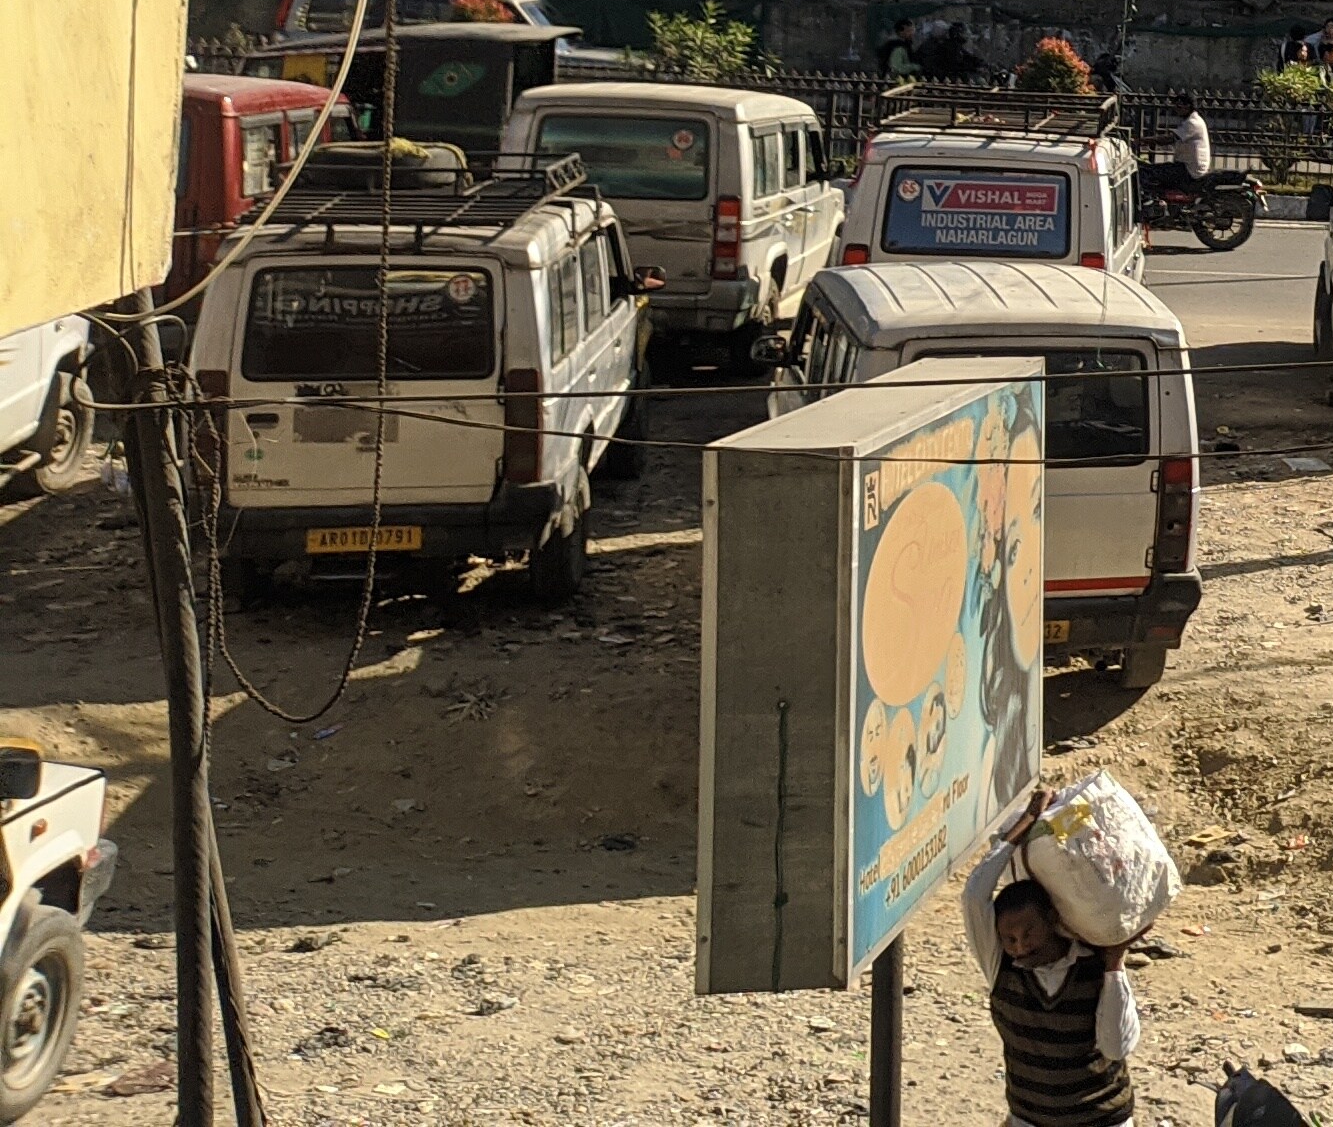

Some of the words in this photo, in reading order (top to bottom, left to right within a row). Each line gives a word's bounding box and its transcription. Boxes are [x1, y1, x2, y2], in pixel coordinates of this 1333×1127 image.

[957, 189, 1022, 205] VISHAL
[921, 213, 1011, 229] INDUSTRIAL
[1014, 216, 1055, 231] AREA
[935, 229, 1038, 245] NAHARLAGUN
